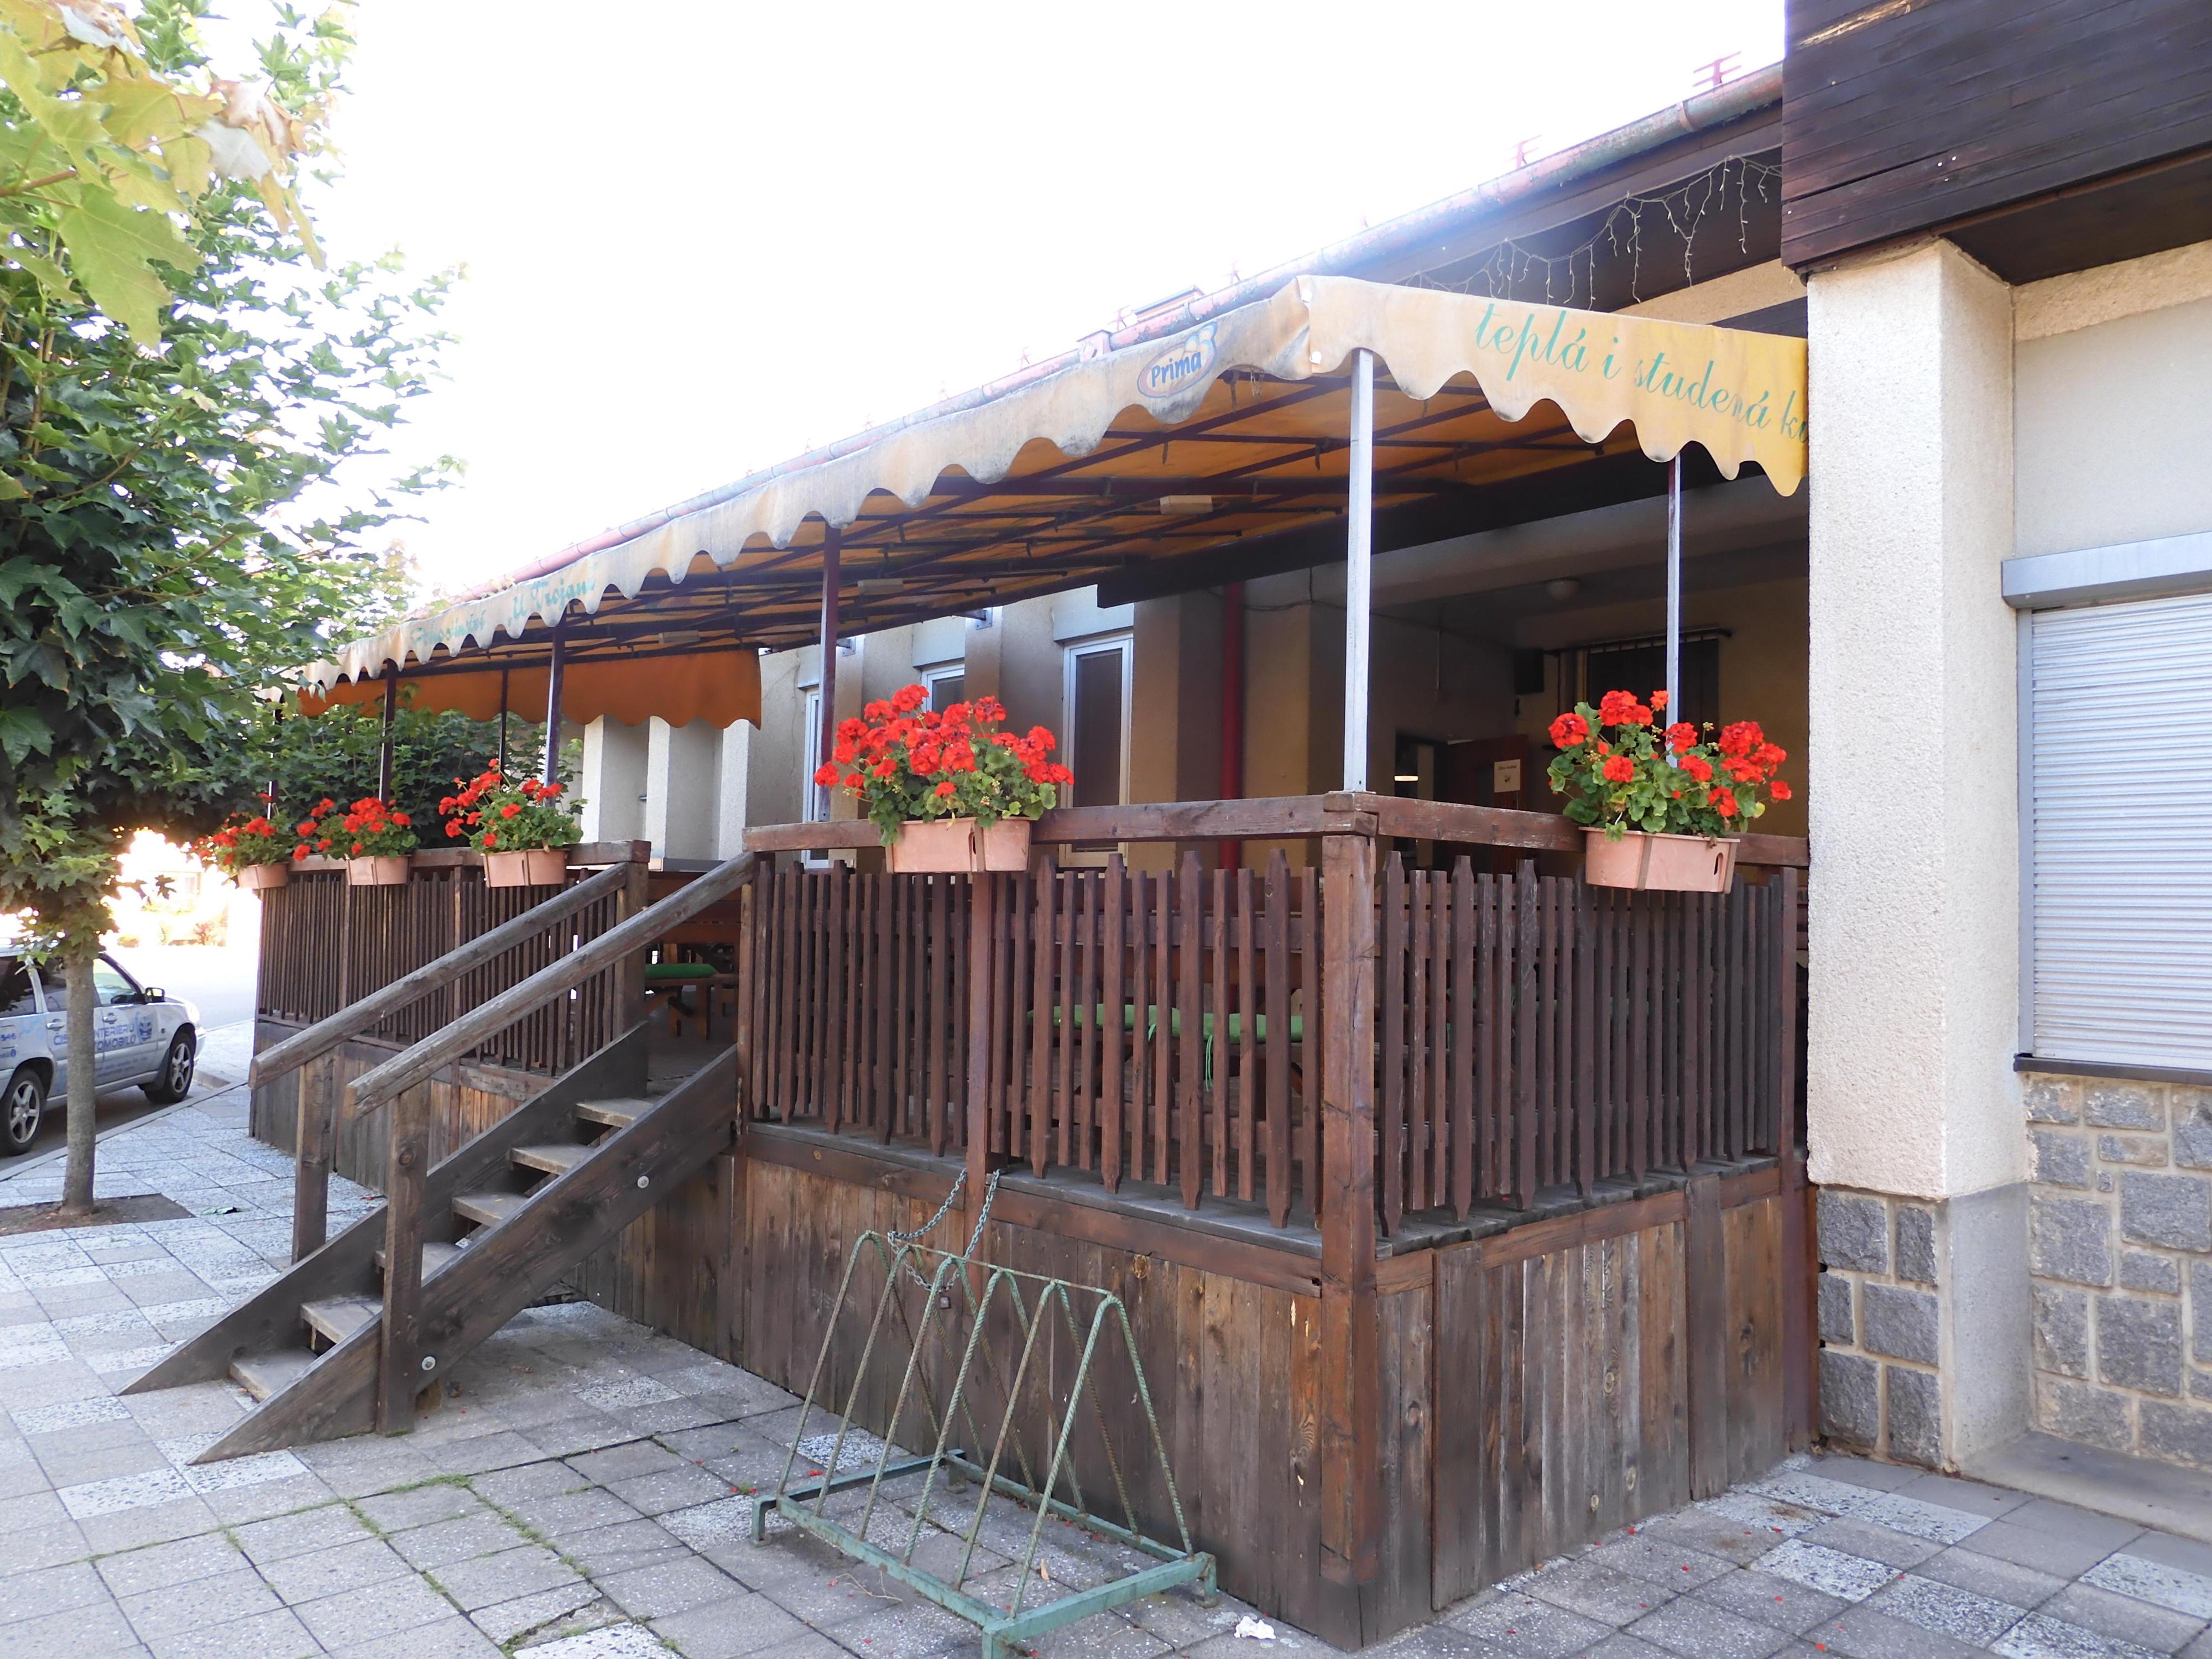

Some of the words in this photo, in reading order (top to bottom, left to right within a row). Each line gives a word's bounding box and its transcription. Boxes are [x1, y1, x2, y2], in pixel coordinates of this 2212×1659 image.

[1150, 351, 1202, 388] Prima
[1474, 302, 1590, 382] teplá
[1603, 336, 1622, 380] i
[1634, 352, 1771, 429] studená
